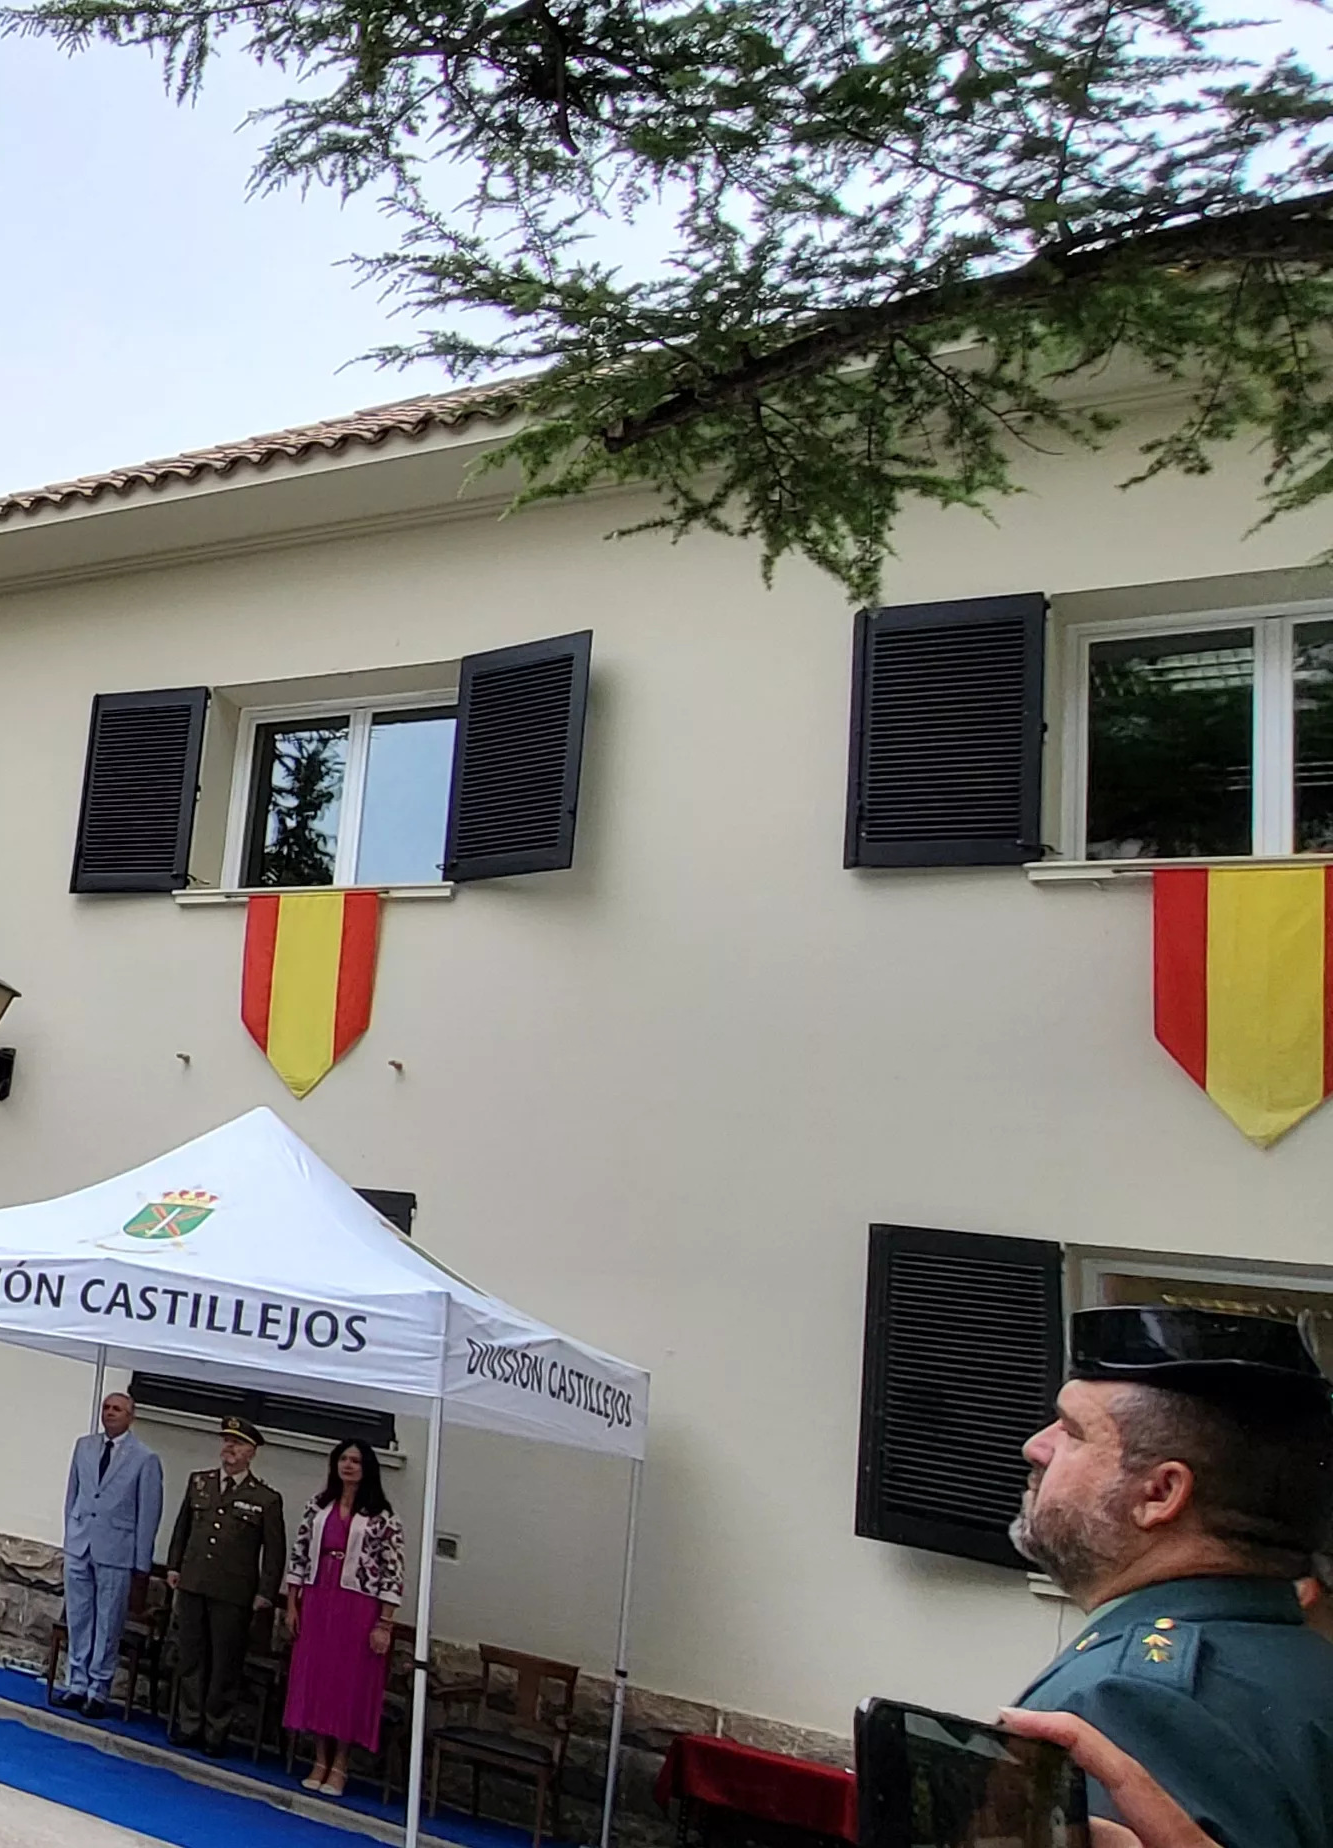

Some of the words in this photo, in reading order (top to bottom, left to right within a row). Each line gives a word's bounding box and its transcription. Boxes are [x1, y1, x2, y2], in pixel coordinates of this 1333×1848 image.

[80, 1278, 368, 1353] CASTILLEJOS
[466, 1337, 544, 1394] DIVISIÓN
[547, 1360, 633, 1428] CASTILLEJOS
